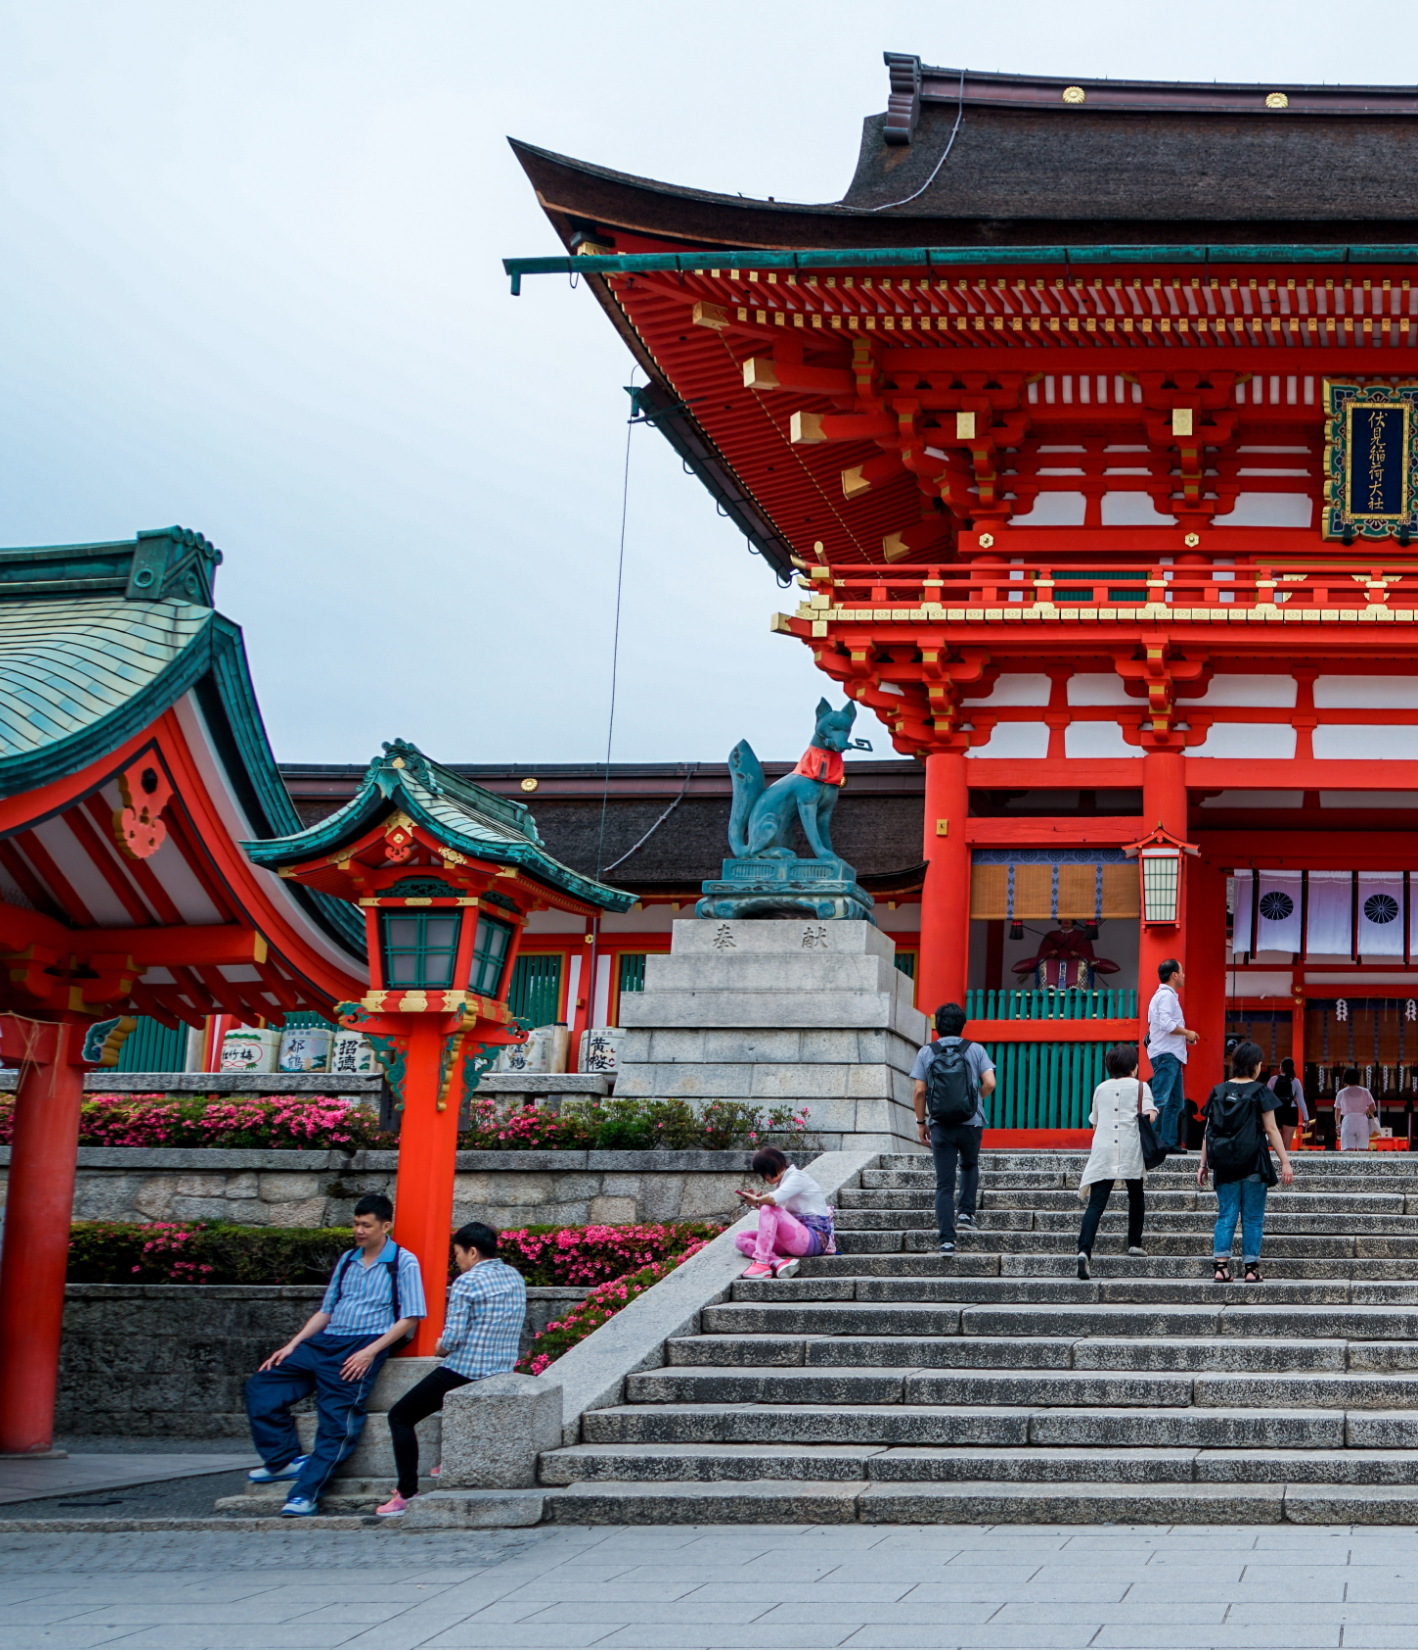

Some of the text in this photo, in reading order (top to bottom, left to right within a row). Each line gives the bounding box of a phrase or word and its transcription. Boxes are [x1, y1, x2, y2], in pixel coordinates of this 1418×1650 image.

[1368, 410, 1388, 511] 伏見稲荷大社
[713, 923, 829, 953] 奉 献
